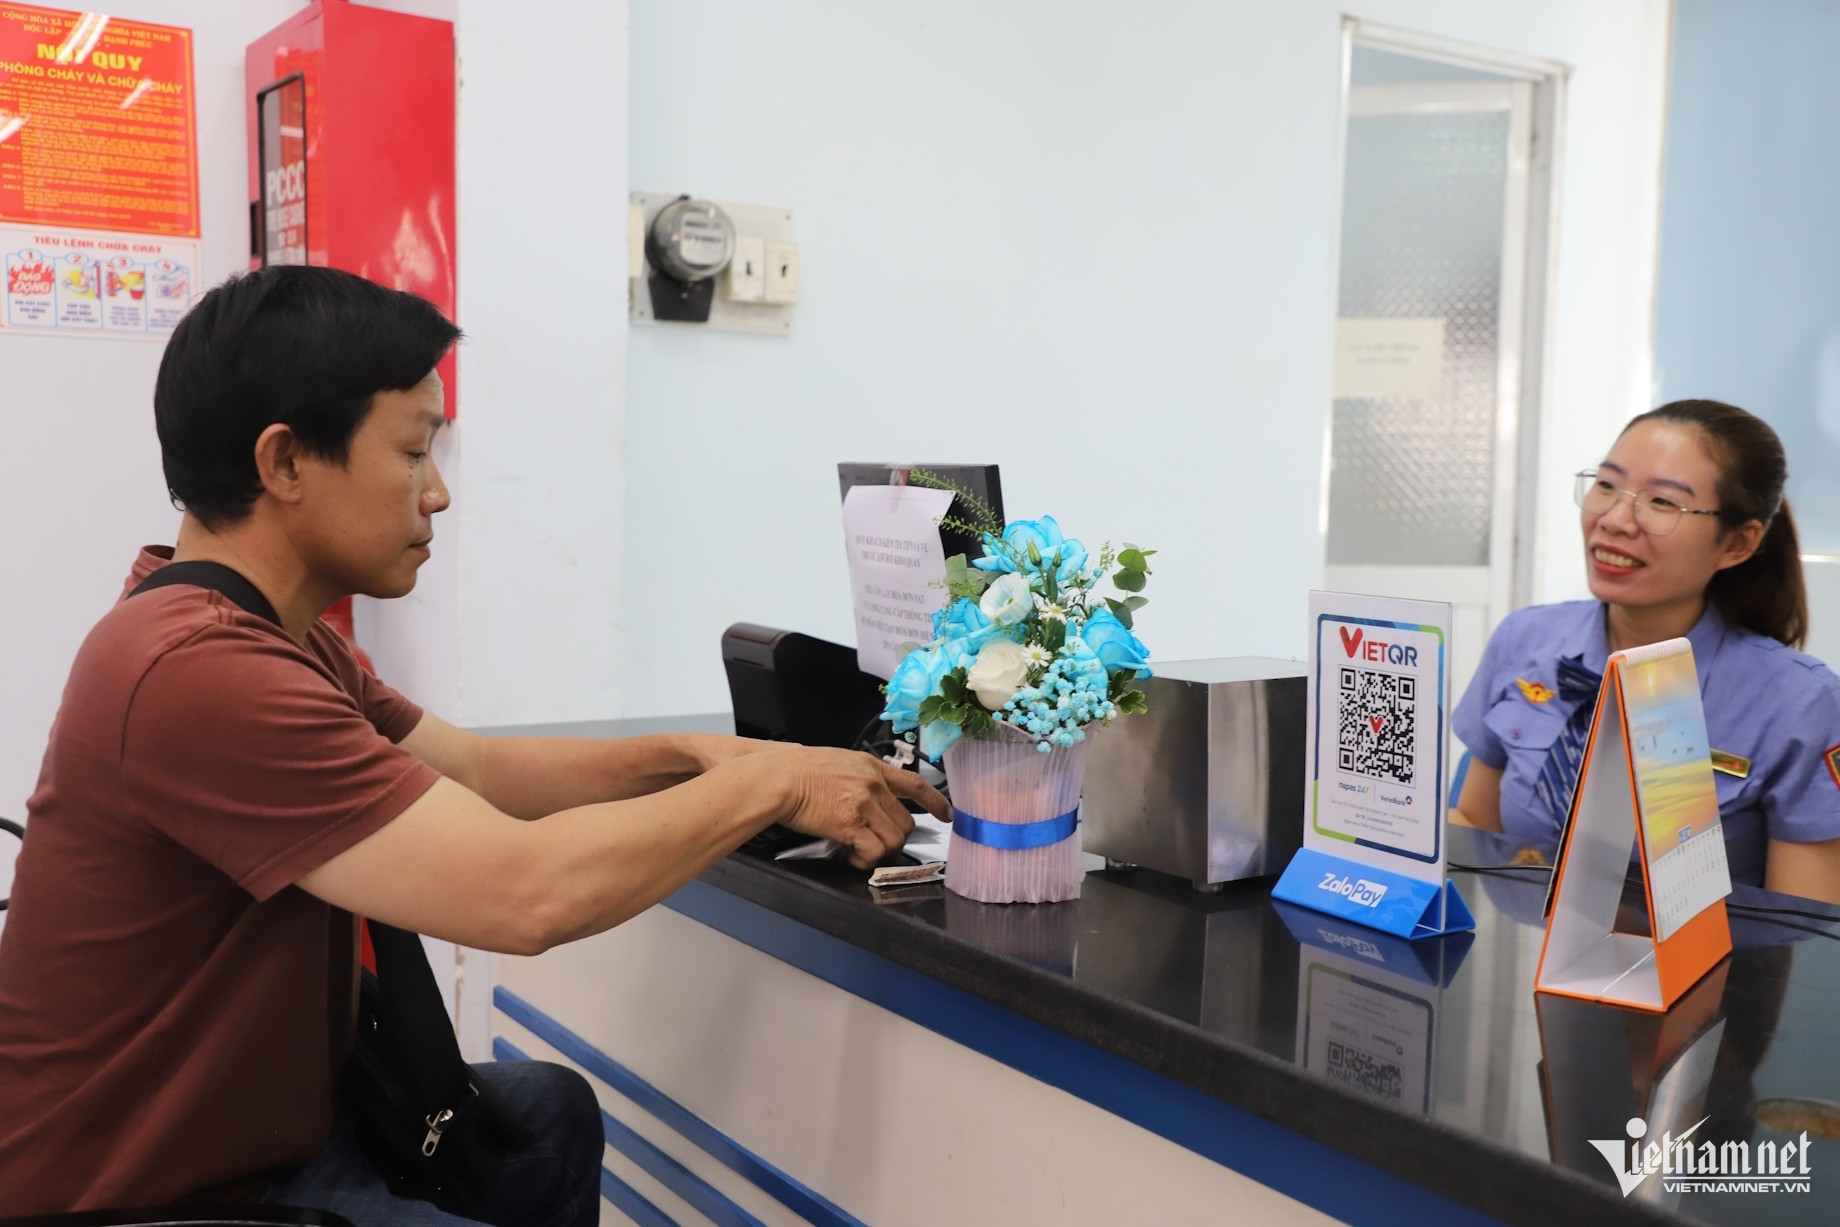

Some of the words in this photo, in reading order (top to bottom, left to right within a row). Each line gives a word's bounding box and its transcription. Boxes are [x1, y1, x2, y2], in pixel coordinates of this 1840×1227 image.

[92, 50, 144, 72] QUY
[47, 65, 85, 83] CHÁY
[86, 70, 106, 84] VÀ
[149, 79, 183, 96] CHÁY
[266, 160, 305, 206] PCCC
[132, 241, 163, 254] CHÁY
[73, 254, 82, 264] 2
[118, 257, 128, 267] 3
[1338, 782, 1356, 791] napas
[1357, 785, 1369, 794] 247
[1318, 872, 1383, 907] ZaloPay
